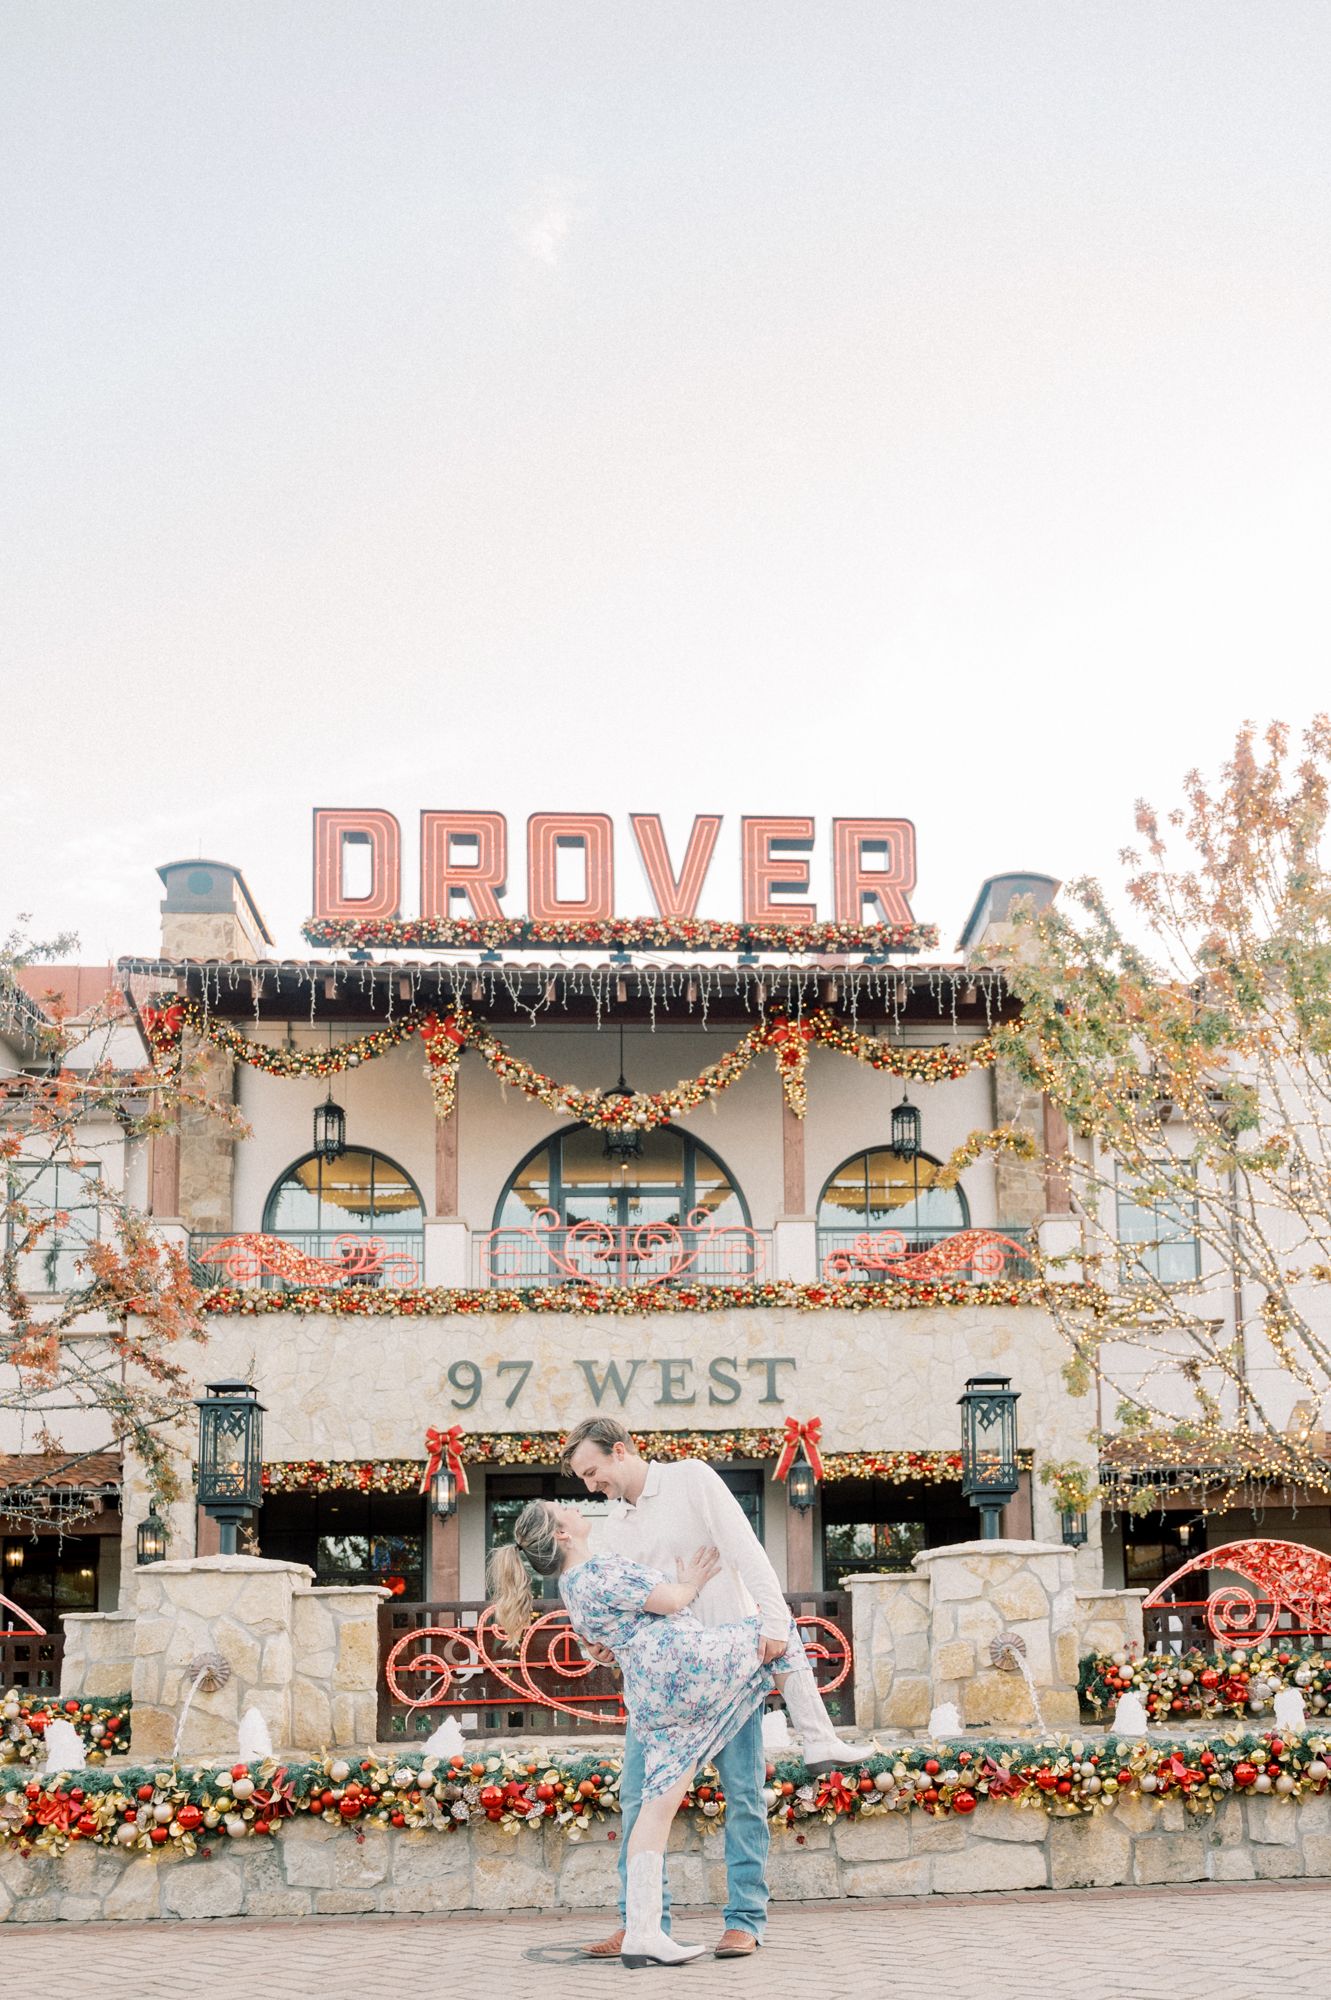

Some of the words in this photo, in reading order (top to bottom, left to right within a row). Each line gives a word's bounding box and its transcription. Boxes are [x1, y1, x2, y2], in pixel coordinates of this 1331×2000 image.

[313, 808, 918, 925] DROVER
[447, 1359, 533, 1409] 97
[573, 1356, 796, 1407] WEST
